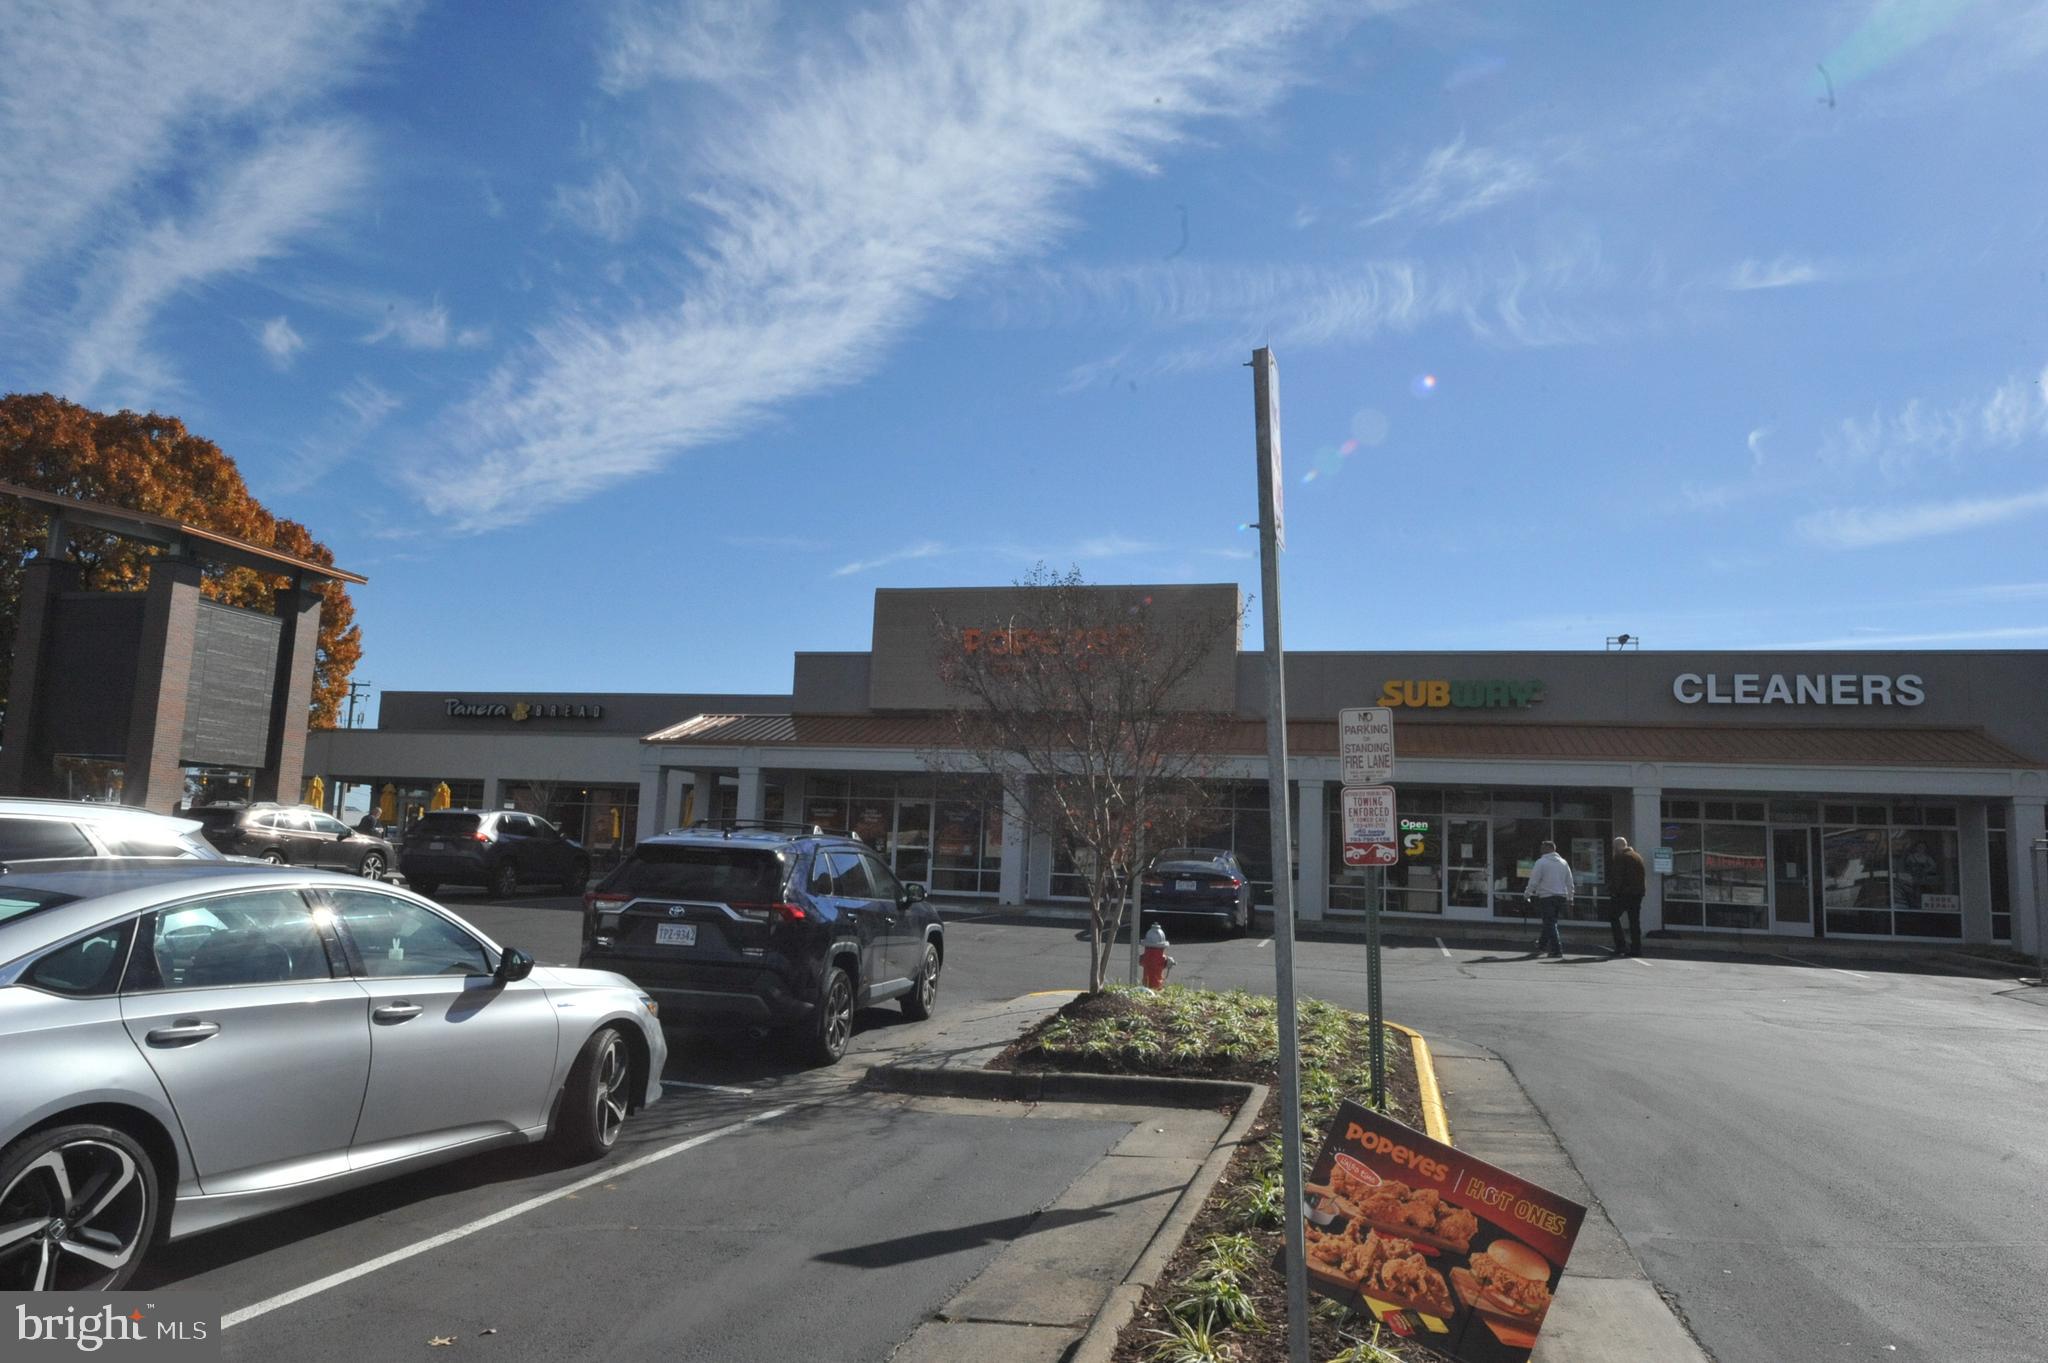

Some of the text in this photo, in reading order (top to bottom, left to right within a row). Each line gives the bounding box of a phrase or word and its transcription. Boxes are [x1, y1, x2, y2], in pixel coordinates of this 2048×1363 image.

[1377, 680, 1544, 707] SUBWAY
[1673, 673, 1925, 706] CLEANERS
[445, 698, 602, 718] Panera BREAD
[1358, 712, 1373, 722] NO
[1344, 723, 1389, 735] PARKING
[1344, 743, 1390, 754] STANDING
[1345, 754, 1391, 769] FIRE LANE
[1353, 796, 1384, 807] TOWING
[1348, 806, 1390, 817] ENFORCED
[1400, 819, 1429, 830] Open
[1465, 1177, 1567, 1236] HOT ONES
